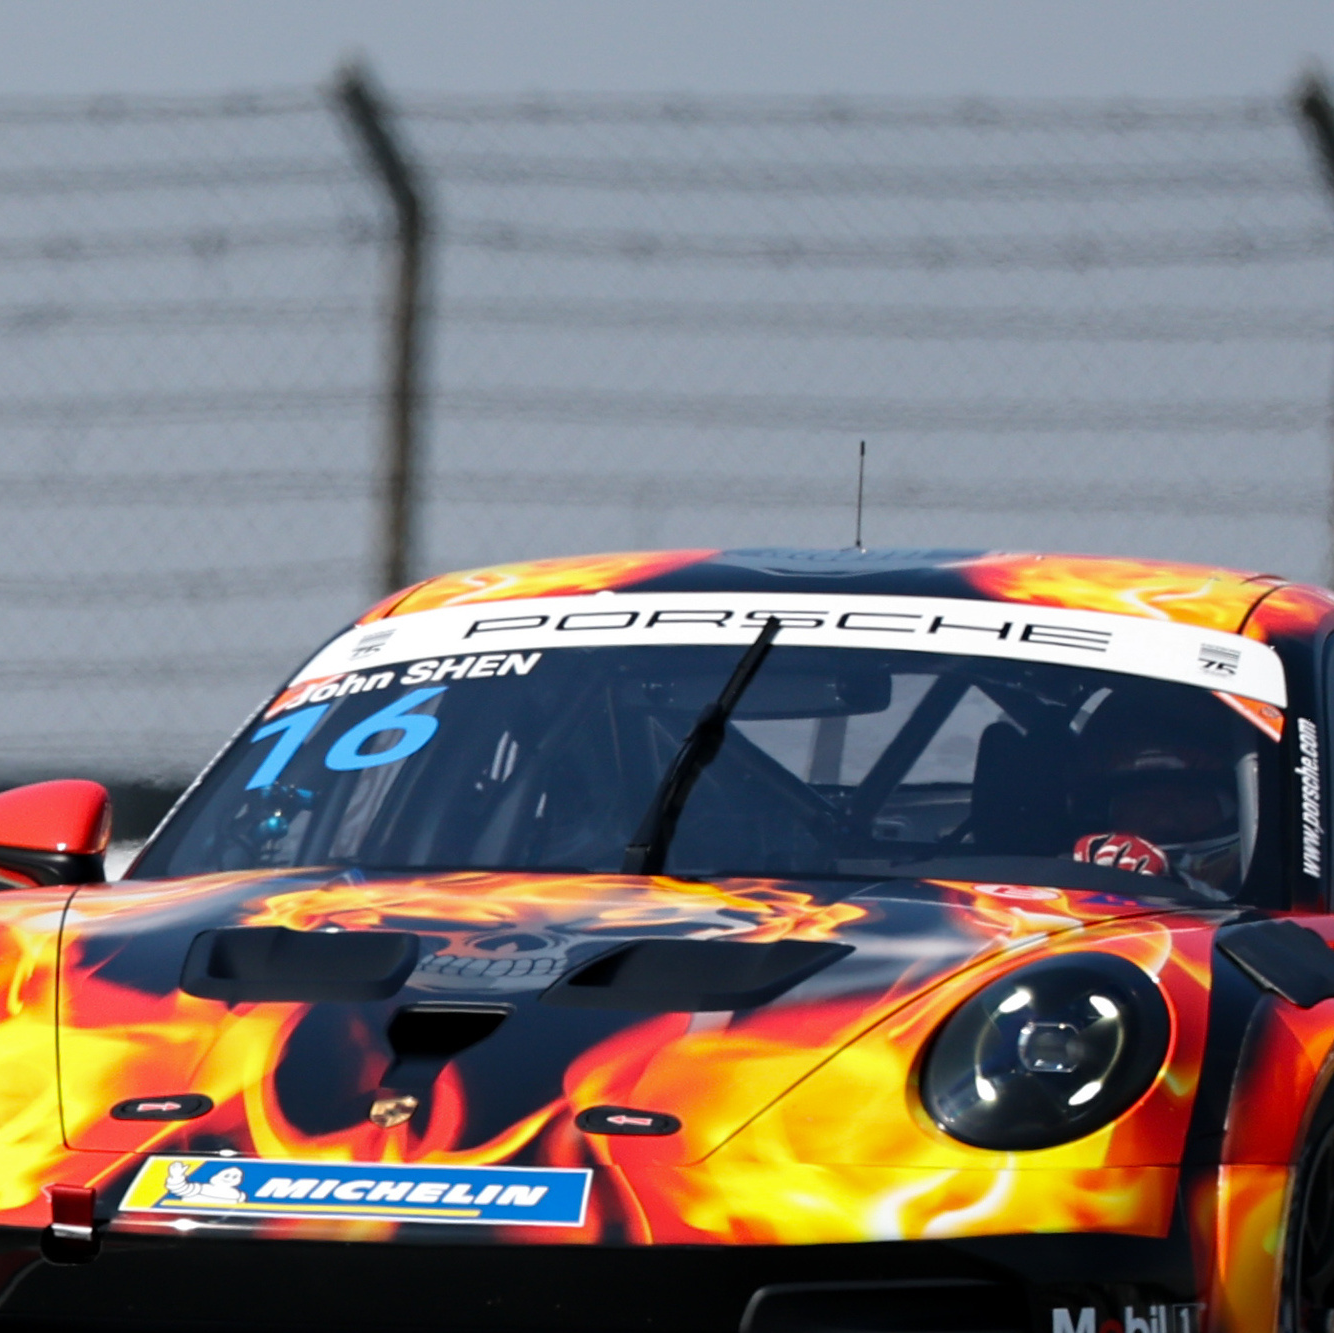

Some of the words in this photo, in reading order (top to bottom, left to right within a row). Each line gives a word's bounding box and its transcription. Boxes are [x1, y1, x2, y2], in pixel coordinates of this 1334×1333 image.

[463, 608, 1113, 653] PORSCHE
[284, 670, 397, 710] John
[399, 651, 543, 686] SHEN
[244, 685, 450, 791] 16
[1294, 716, 1325, 879] www.porsche.com
[254, 1176, 549, 1208] MICHELIN
